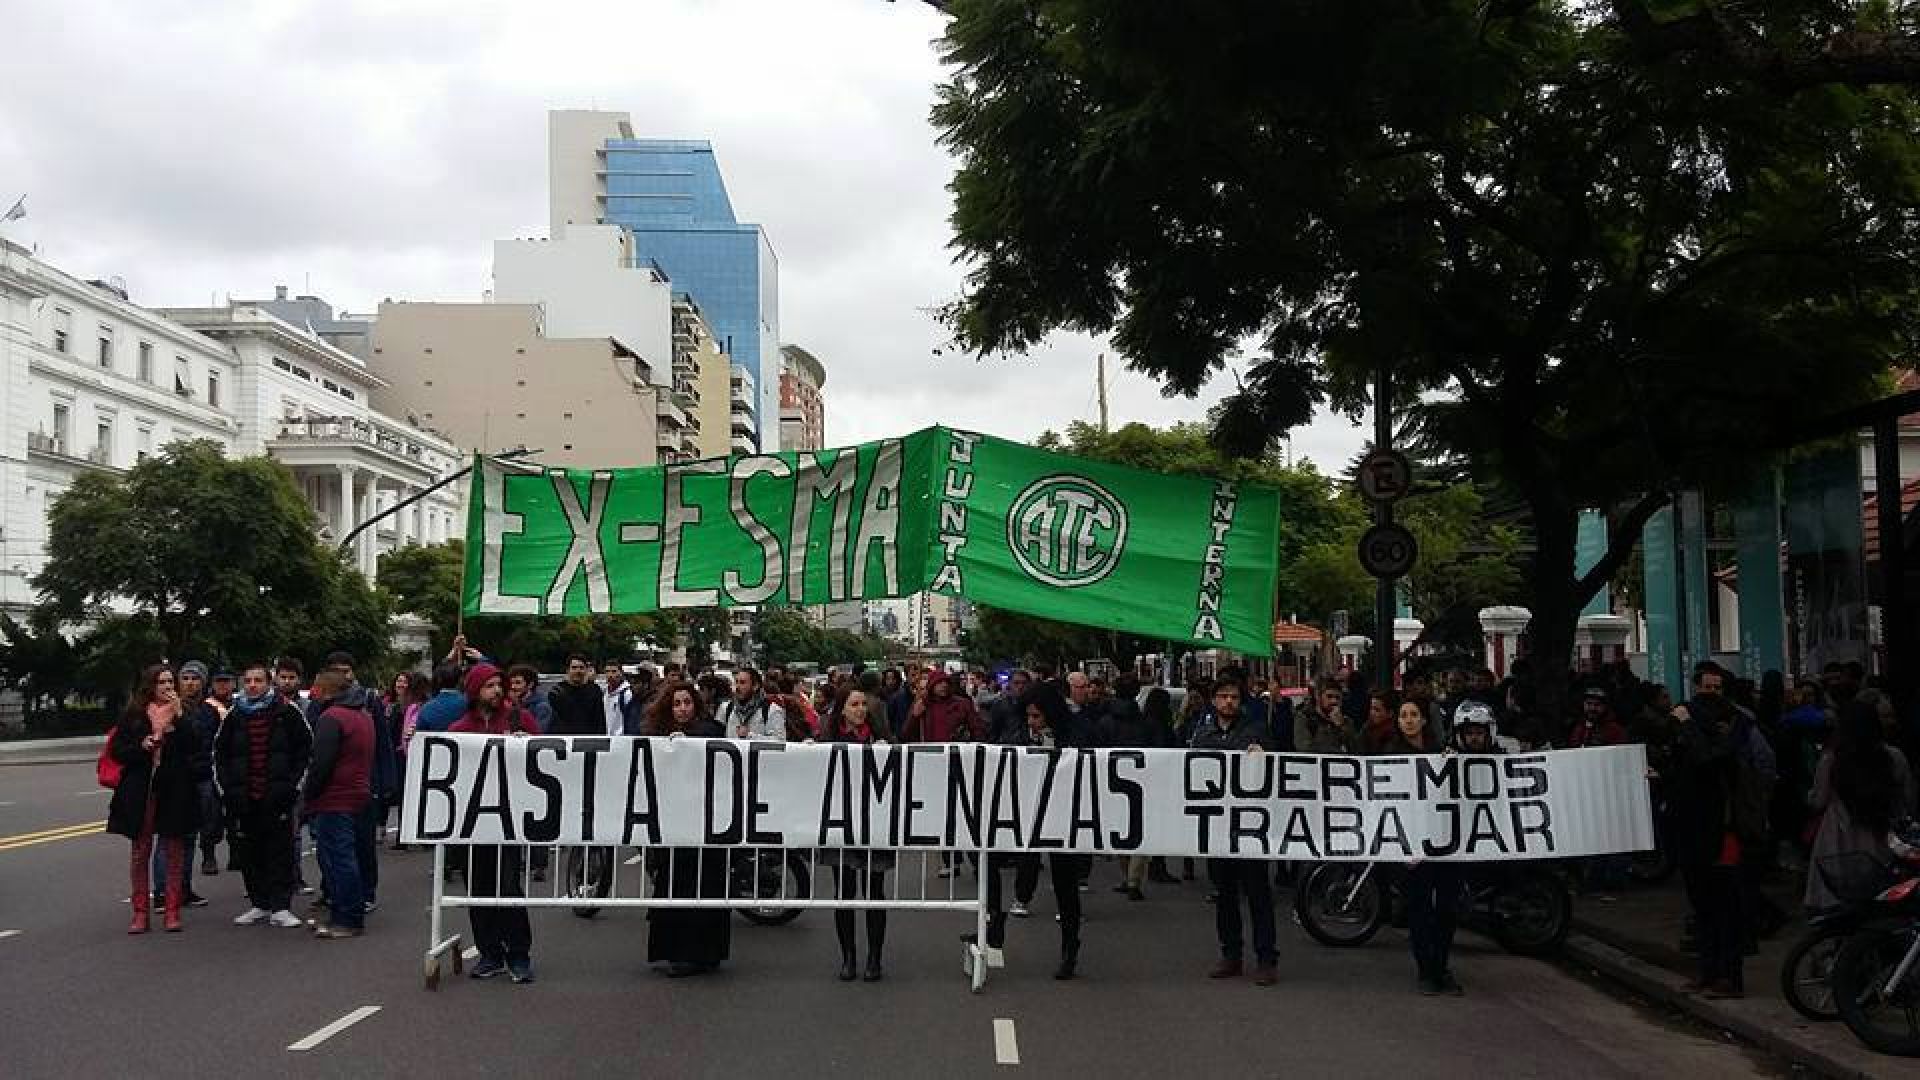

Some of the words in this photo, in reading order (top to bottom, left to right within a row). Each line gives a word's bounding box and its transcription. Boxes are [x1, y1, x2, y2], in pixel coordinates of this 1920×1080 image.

[478, 438, 904, 615] EX-ESMA
[930, 430, 983, 594] JUNTA
[1020, 489, 1113, 575] ATE
[1193, 480, 1237, 641] INTERNA
[1371, 541, 1404, 562] 60
[415, 736, 662, 845] BASTA
[704, 739, 786, 845] DE
[818, 743, 1147, 850] AMENAZAS
[1184, 751, 1549, 801] QUEREMOS
[1184, 801, 1556, 858] TRABAJAR
